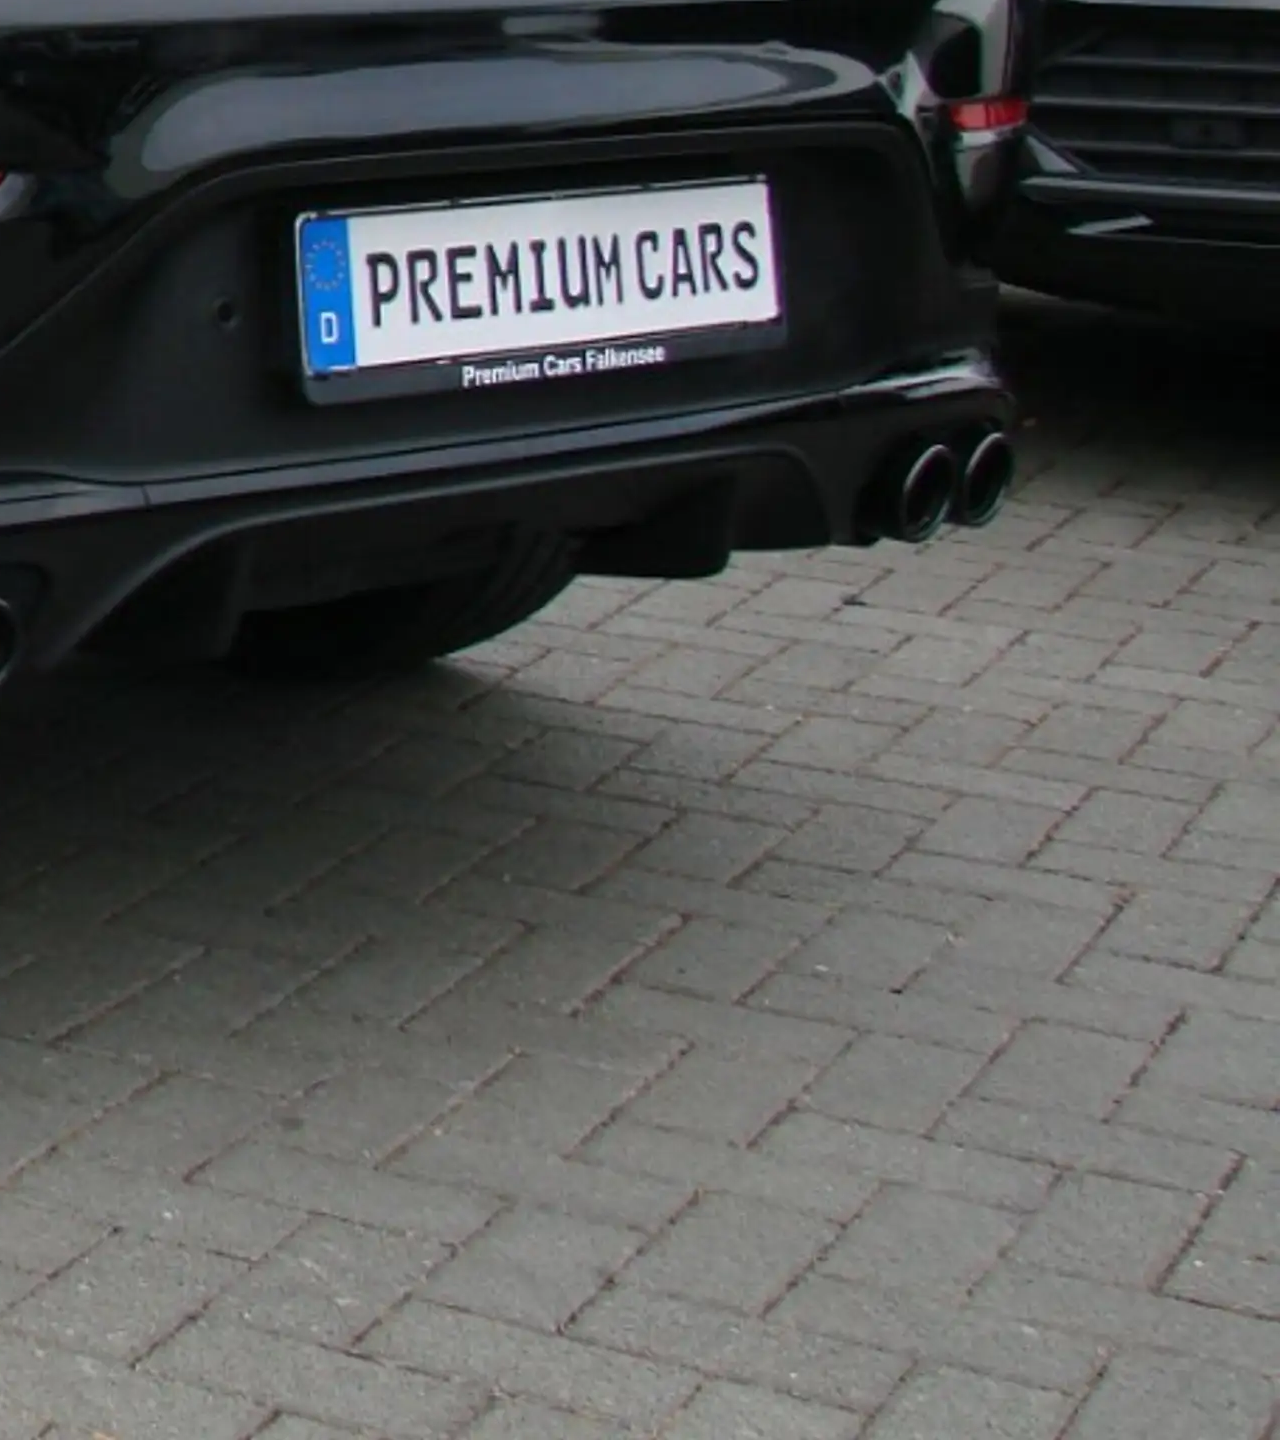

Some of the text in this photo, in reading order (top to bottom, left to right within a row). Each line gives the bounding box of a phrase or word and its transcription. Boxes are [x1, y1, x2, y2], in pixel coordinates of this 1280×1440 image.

[366, 220, 760, 328] PREMIUM CARS
[320, 311, 341, 344] D
[462, 344, 666, 389] Premium Cars Falkensee
